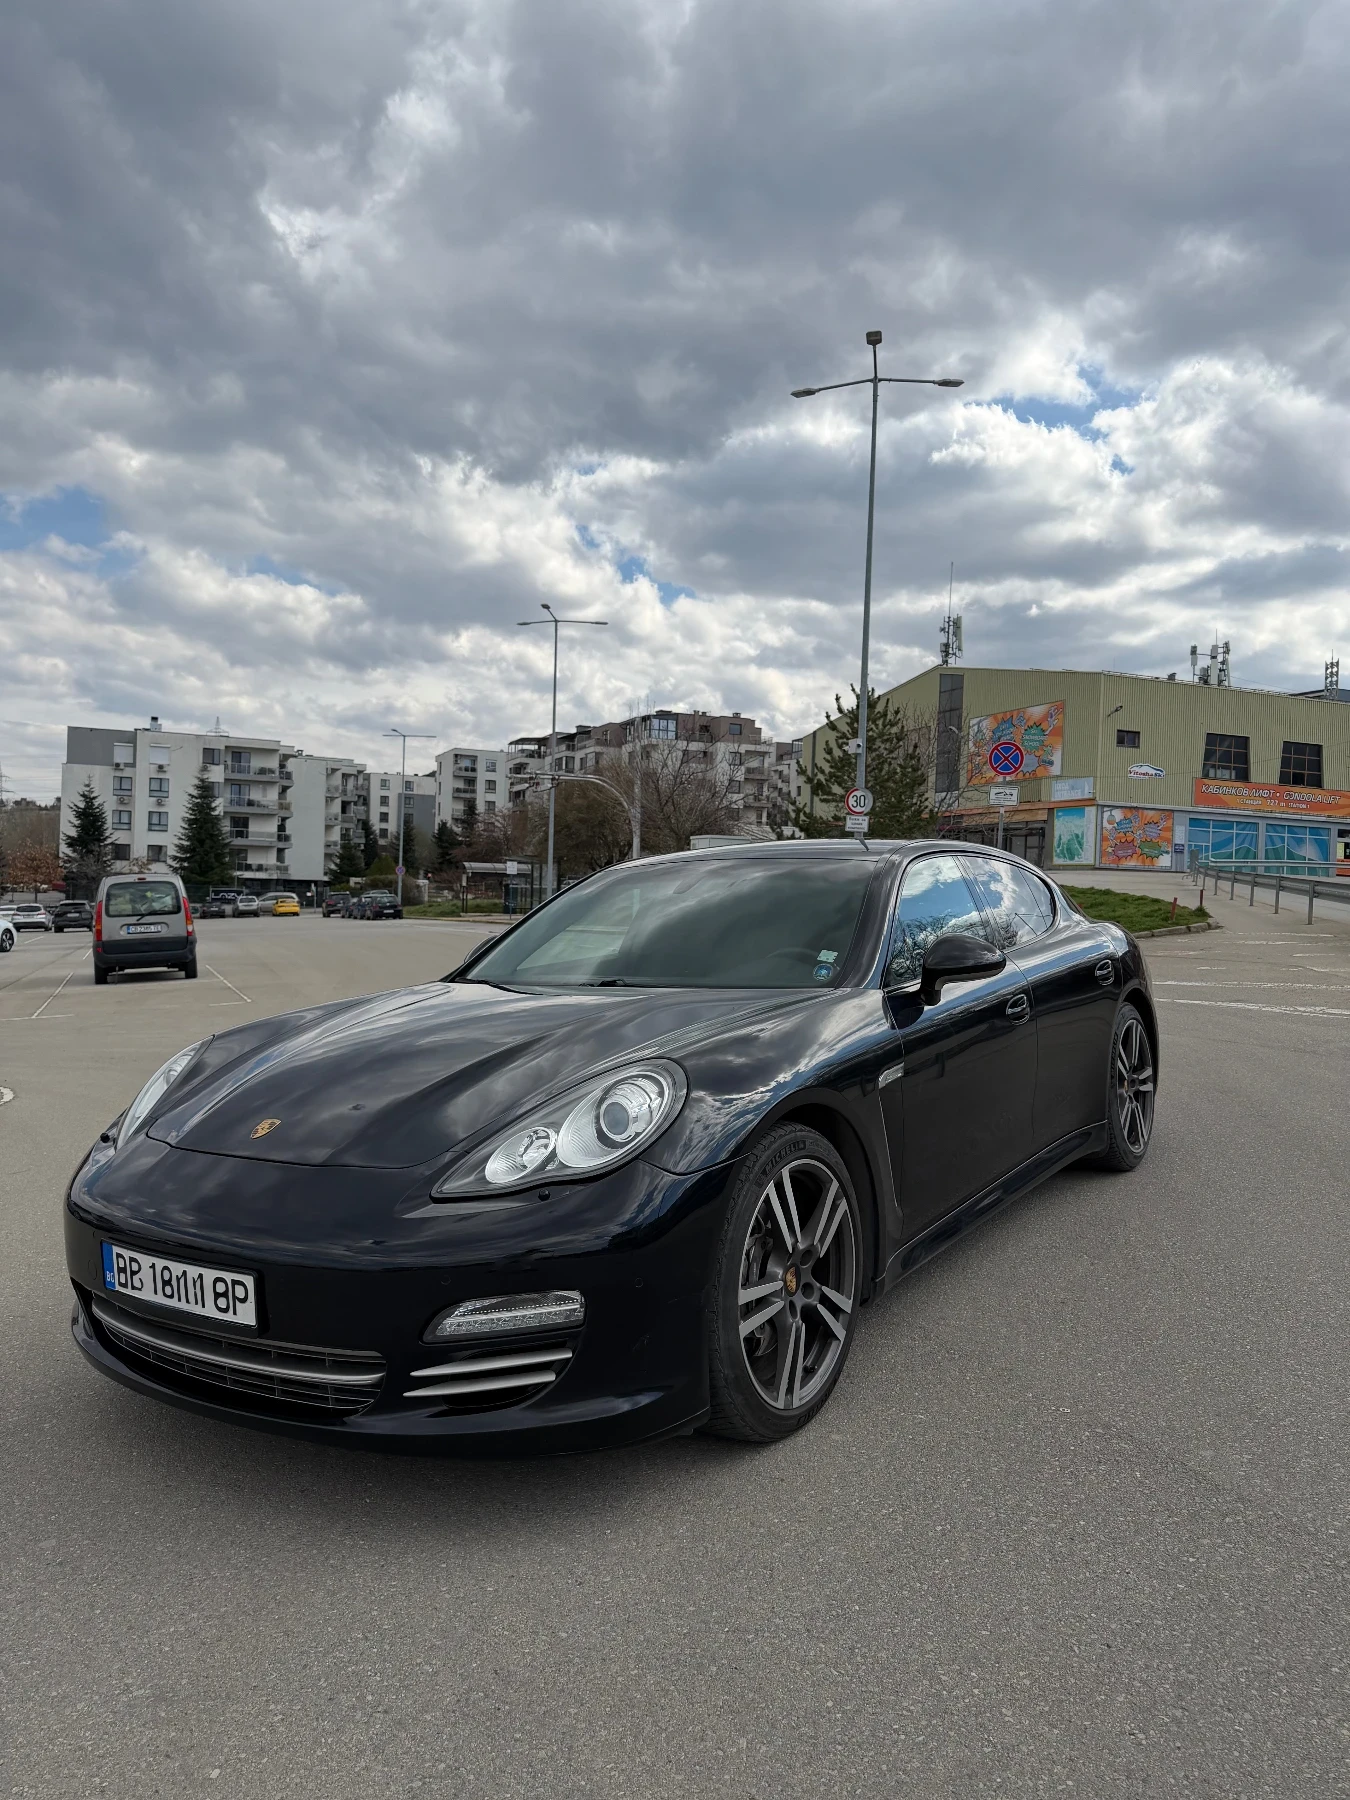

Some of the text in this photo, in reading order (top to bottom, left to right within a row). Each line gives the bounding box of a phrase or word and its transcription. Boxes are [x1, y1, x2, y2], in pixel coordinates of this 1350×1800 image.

[1201, 785, 1276, 798] КАБИНКОВ ЛИФТ
[1283, 791, 1341, 804] GONDOLA LIFT
[851, 794, 866, 808] 30
